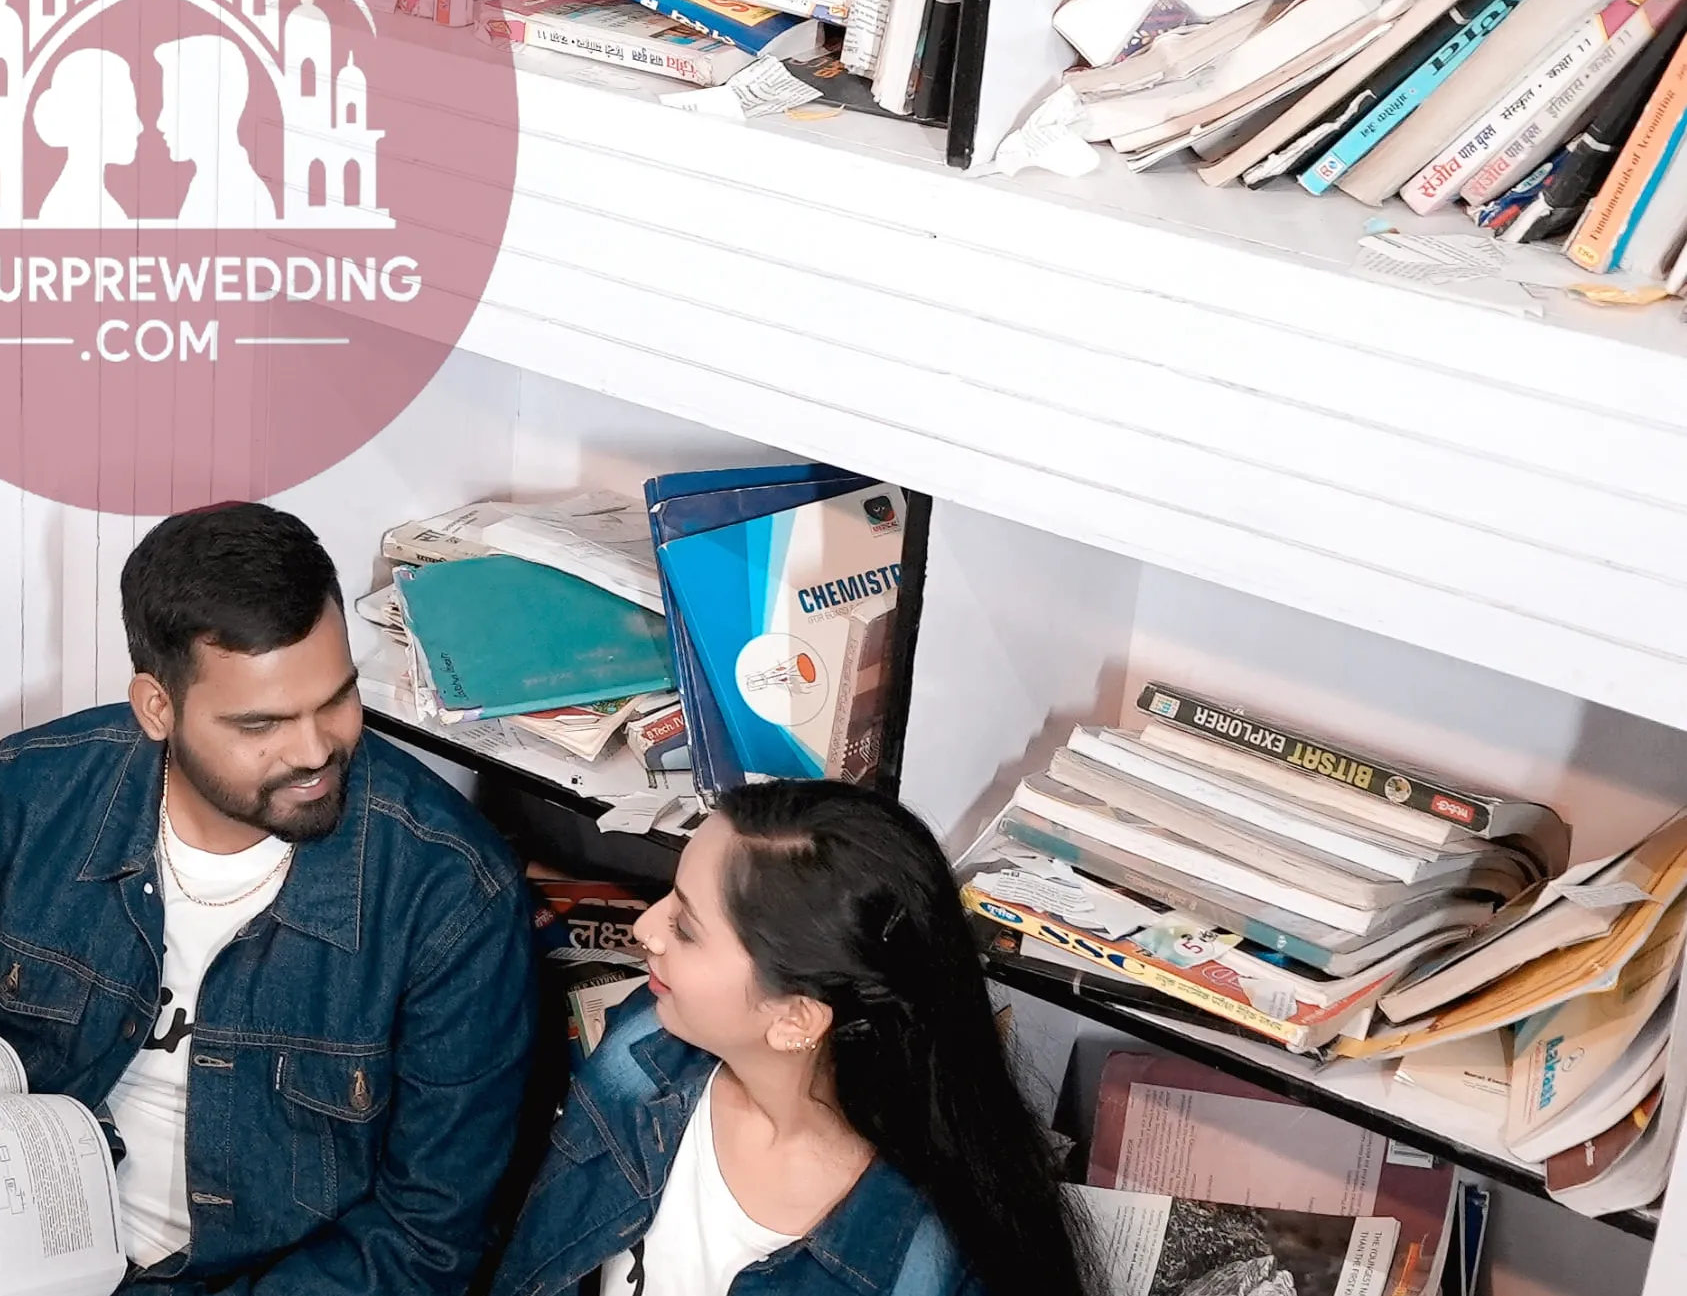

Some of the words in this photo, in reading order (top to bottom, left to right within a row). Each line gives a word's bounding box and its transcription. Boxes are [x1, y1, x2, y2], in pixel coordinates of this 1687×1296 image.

[1497, 86, 1538, 124] संस्कृत
[1544, 76, 1587, 120] इतिहास
[1587, 165, 1636, 241] Fundamentals
[1635, 88, 1677, 151] Accounting
[1190, 705, 1286, 754] EXPLORER
[1285, 739, 1375, 790] BITSAT
[1037, 924, 1147, 977] SSC
[1537, 1034, 1564, 1109] Aakash
[1354, 1230, 1369, 1254] THAN
[1358, 1247, 1379, 1286] YOUNGEST
